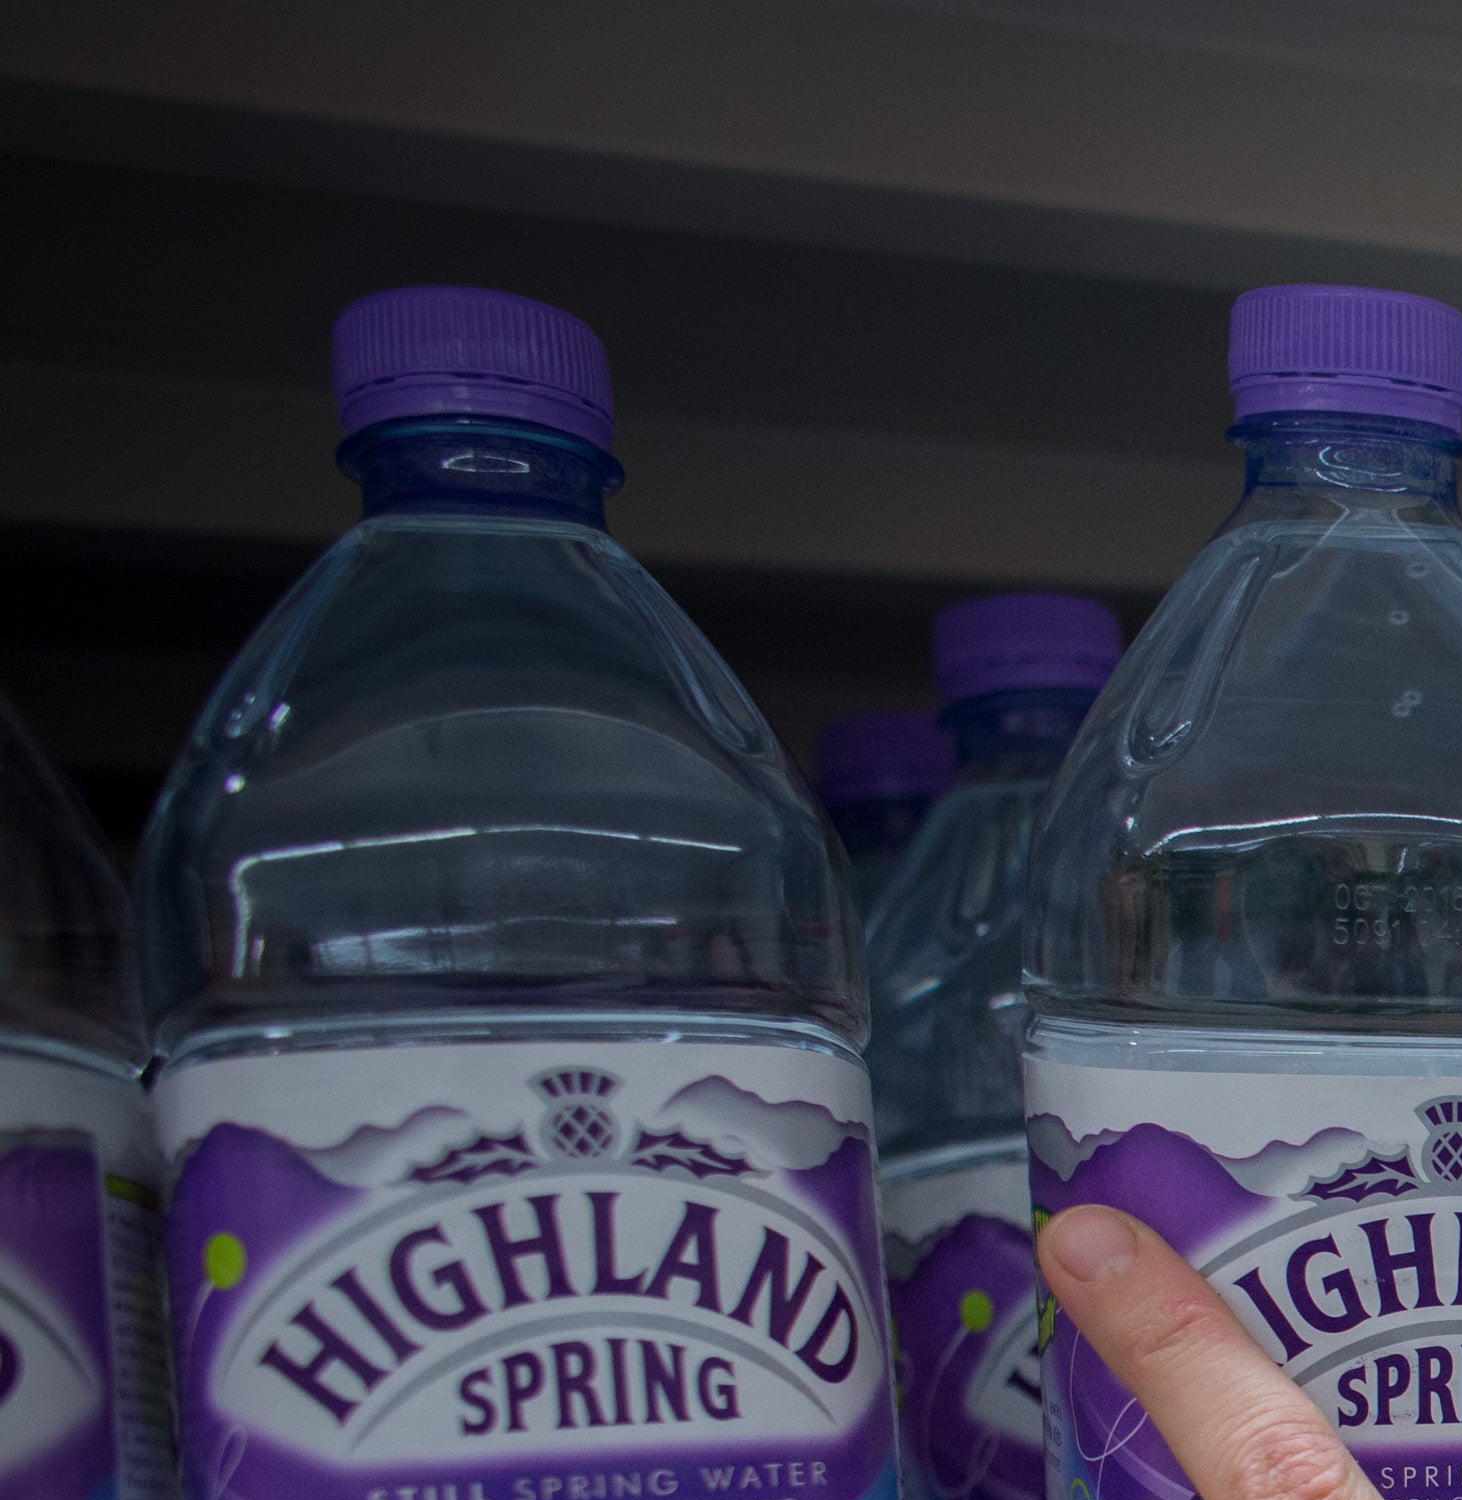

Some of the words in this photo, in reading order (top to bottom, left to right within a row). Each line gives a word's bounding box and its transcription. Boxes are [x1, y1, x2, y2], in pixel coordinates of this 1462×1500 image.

[259, 1190, 860, 1427] HIGHLAND
[458, 1337, 743, 1437] SPRING
[699, 1460, 830, 1491] WATER
